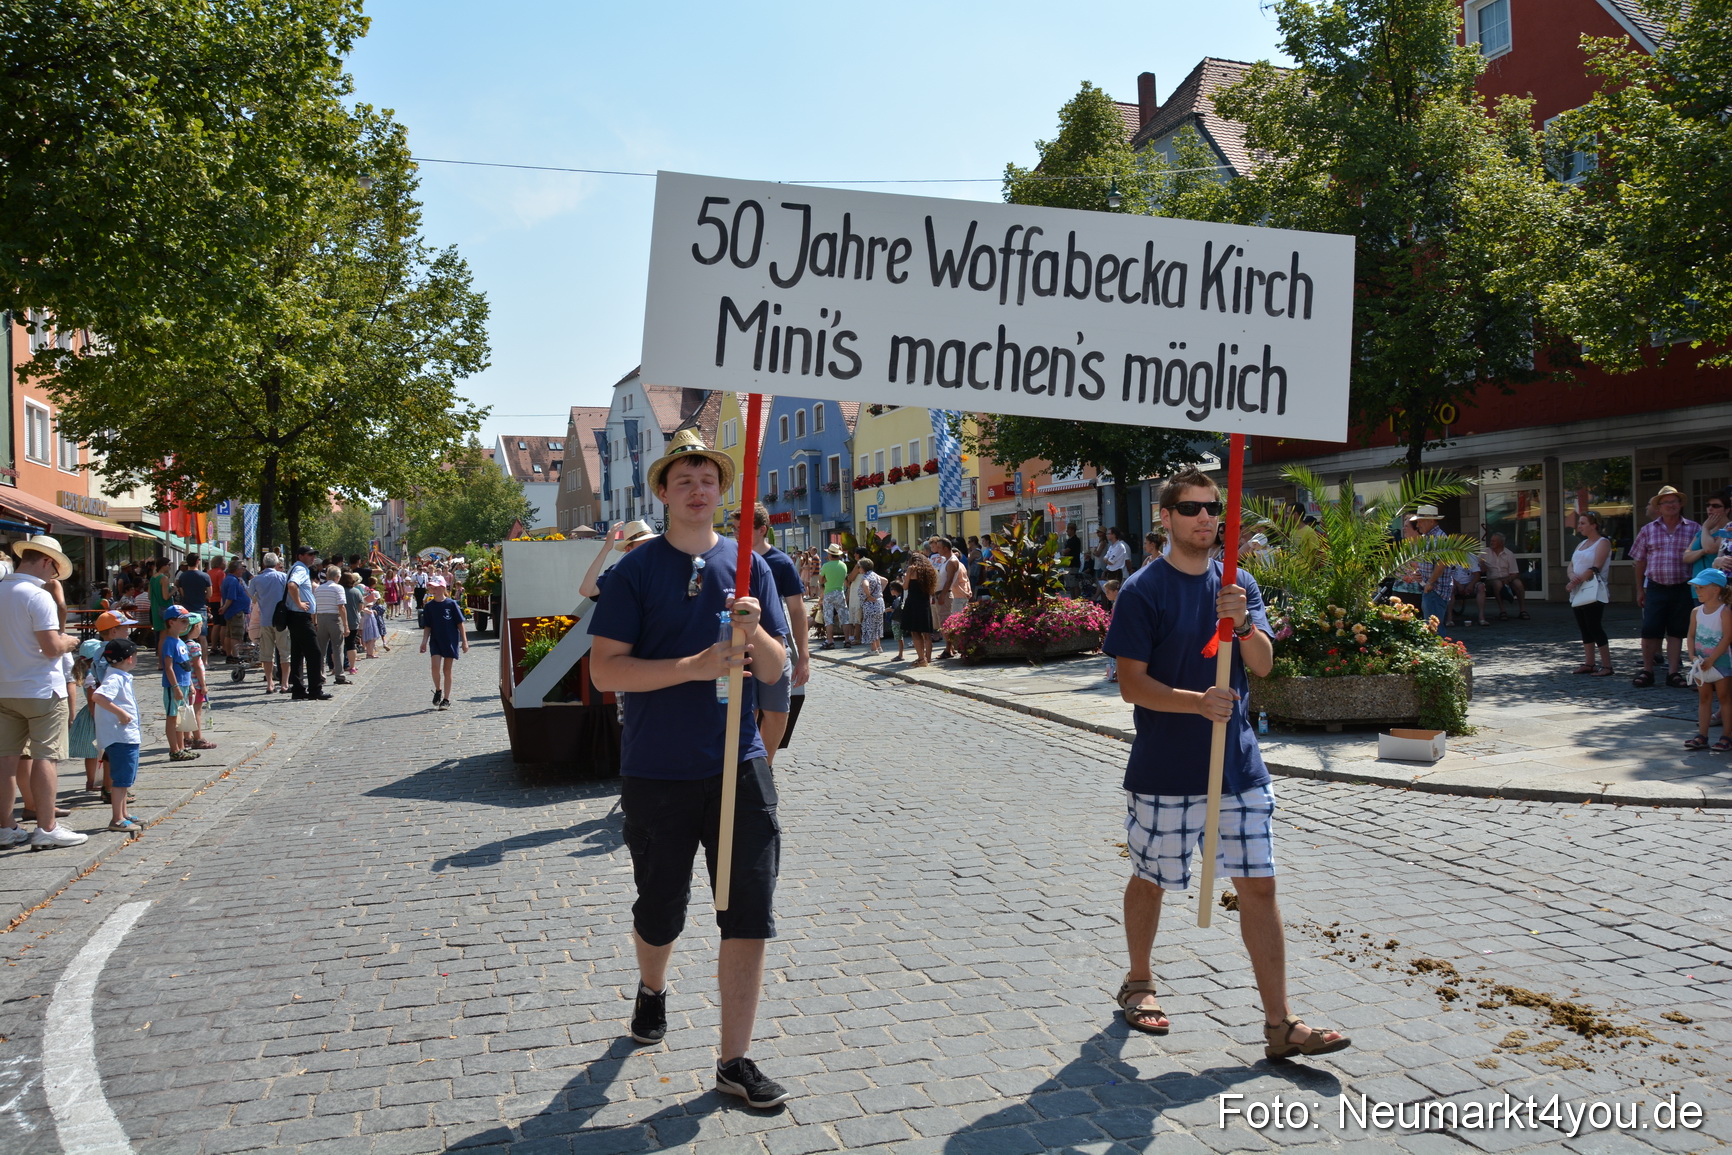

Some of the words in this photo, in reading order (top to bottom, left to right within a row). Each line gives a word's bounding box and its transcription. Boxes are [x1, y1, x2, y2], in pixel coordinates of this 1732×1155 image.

[692, 196, 764, 268] 50
[769, 202, 912, 289] Jahre
[925, 215, 1188, 306] Woffabecka
[1200, 240, 1314, 320] Kirch
[715, 296, 862, 380] Mini's
[889, 323, 1106, 401] machen's
[1122, 341, 1288, 422] möglich
[869, 506, 876, 520] P
